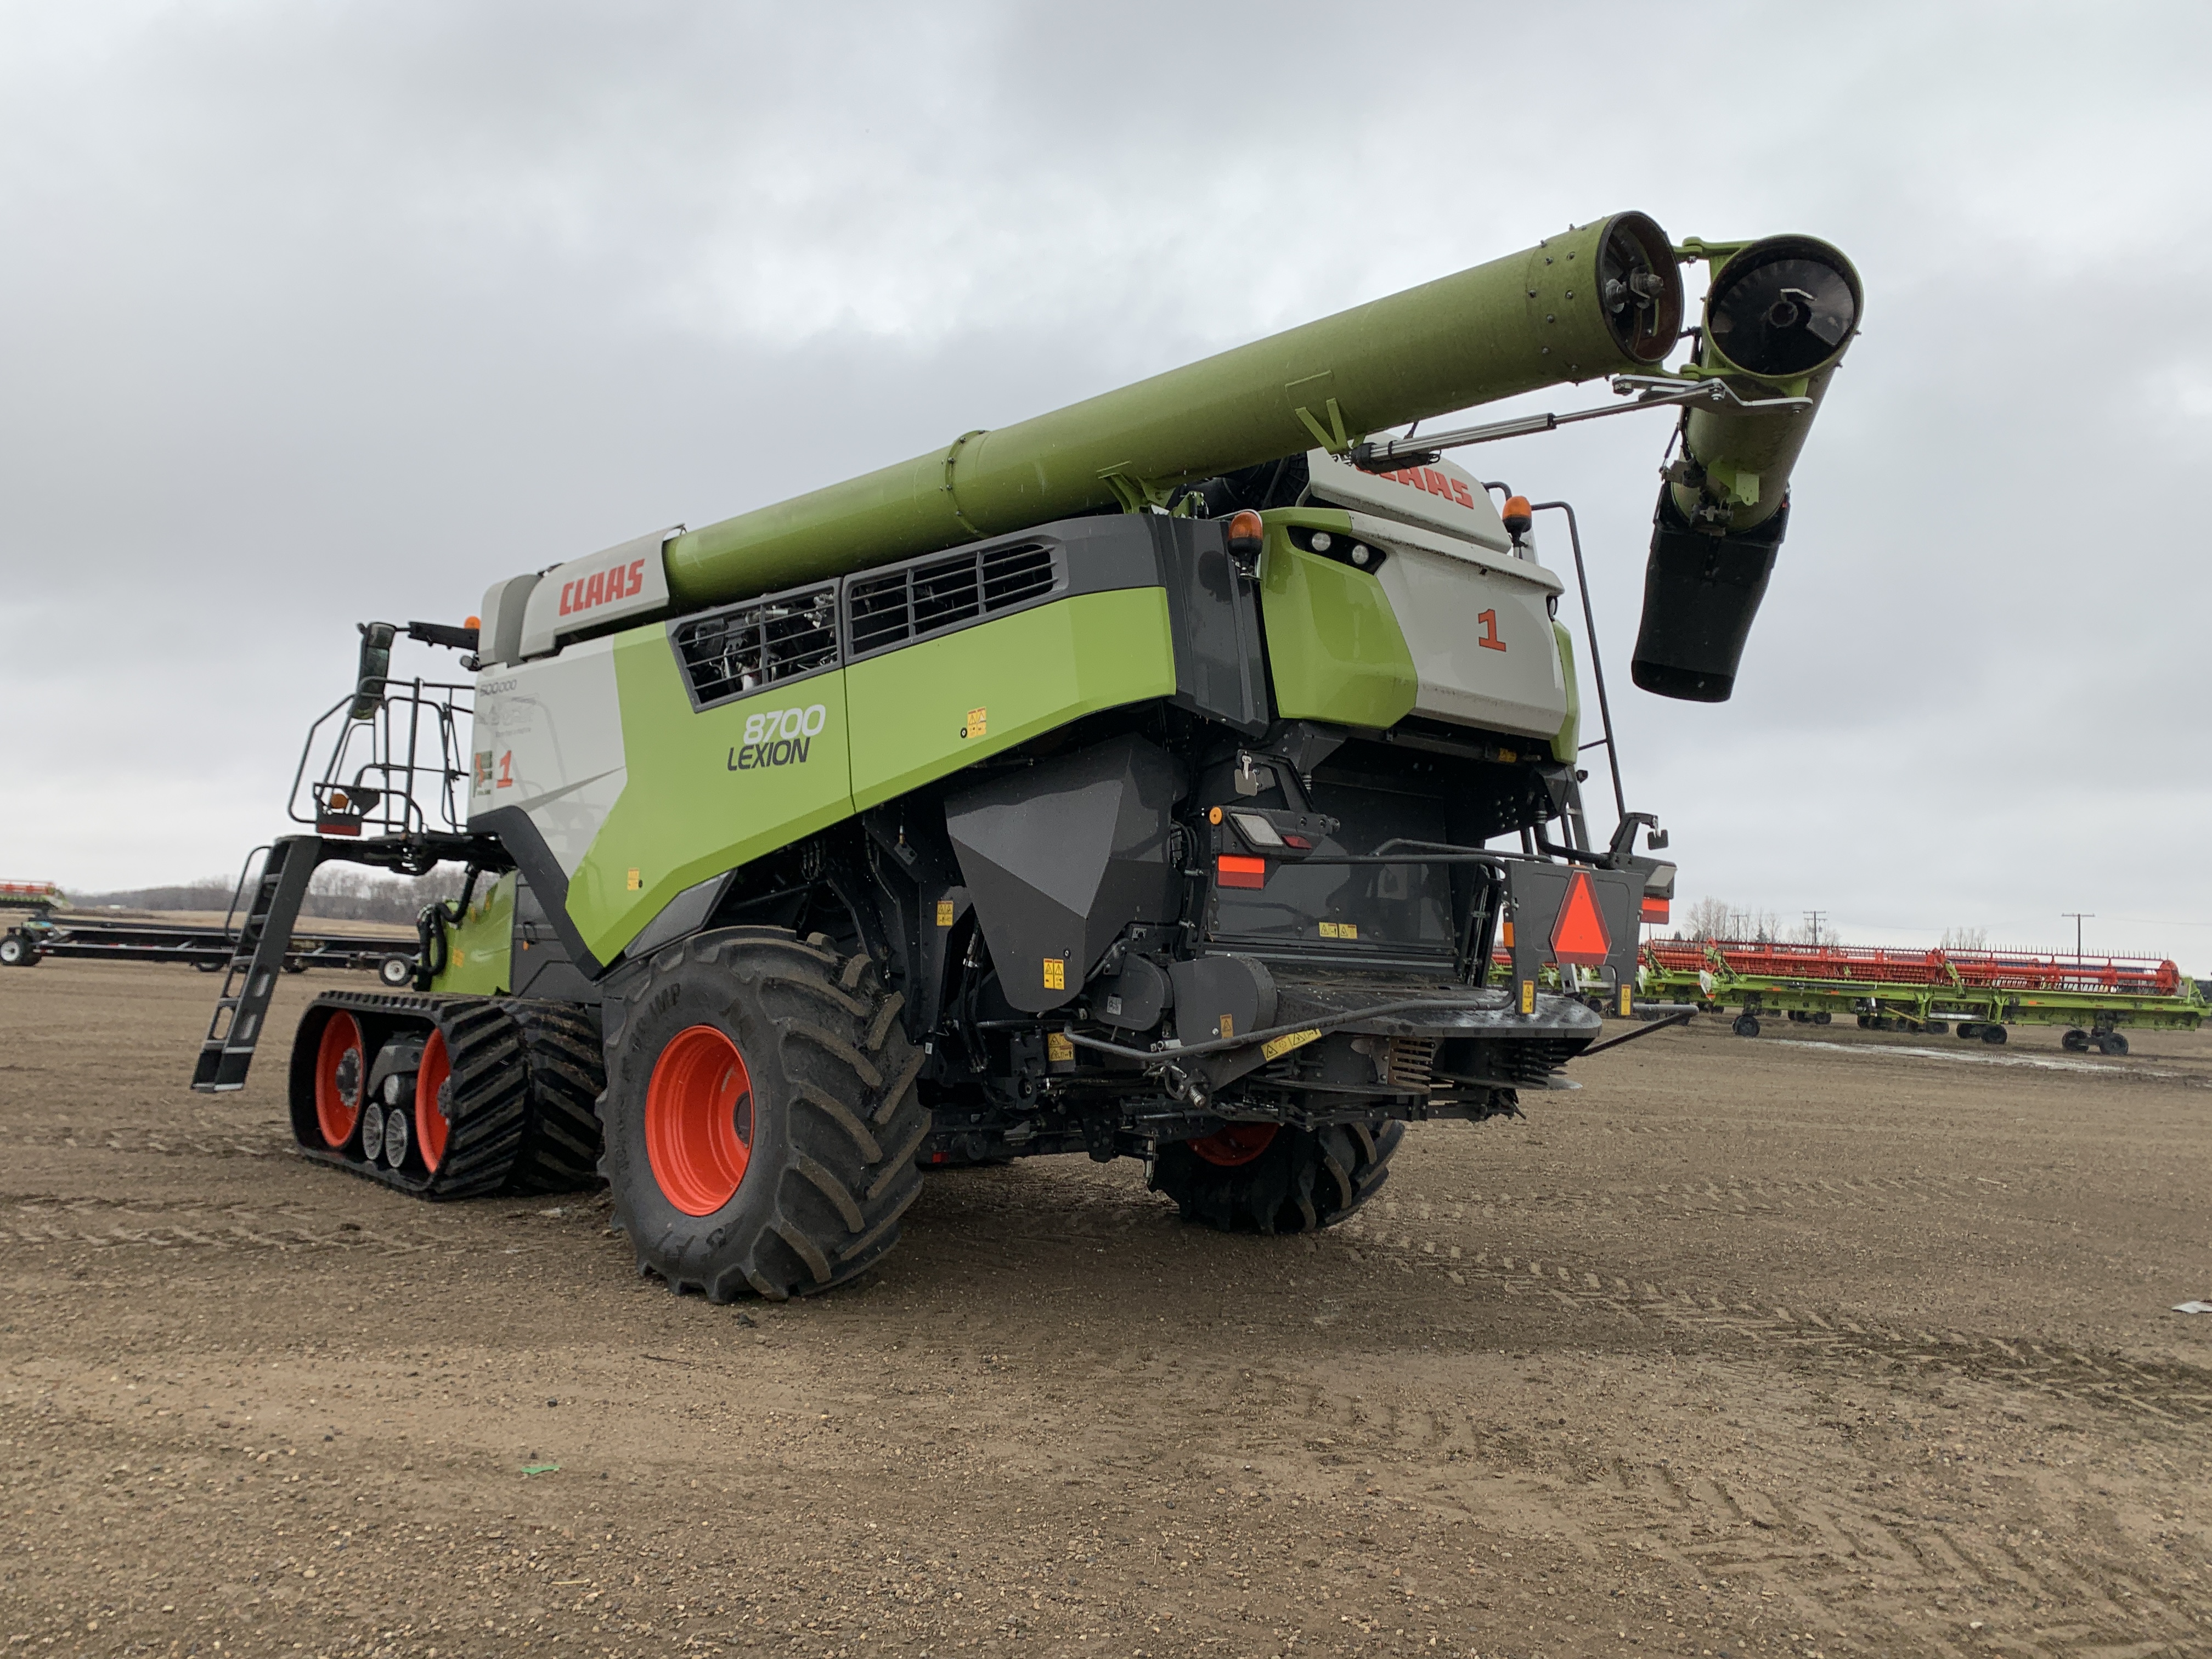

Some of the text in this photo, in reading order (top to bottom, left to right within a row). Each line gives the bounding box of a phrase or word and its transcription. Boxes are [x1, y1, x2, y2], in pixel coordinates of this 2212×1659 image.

[1355, 466, 1474, 510] AAS
[559, 558, 645, 617] CLAAS
[1478, 608, 1506, 652] 1
[743, 704, 826, 745] 8700
[496, 750, 513, 788] 1
[727, 737, 810, 771] LEXION
